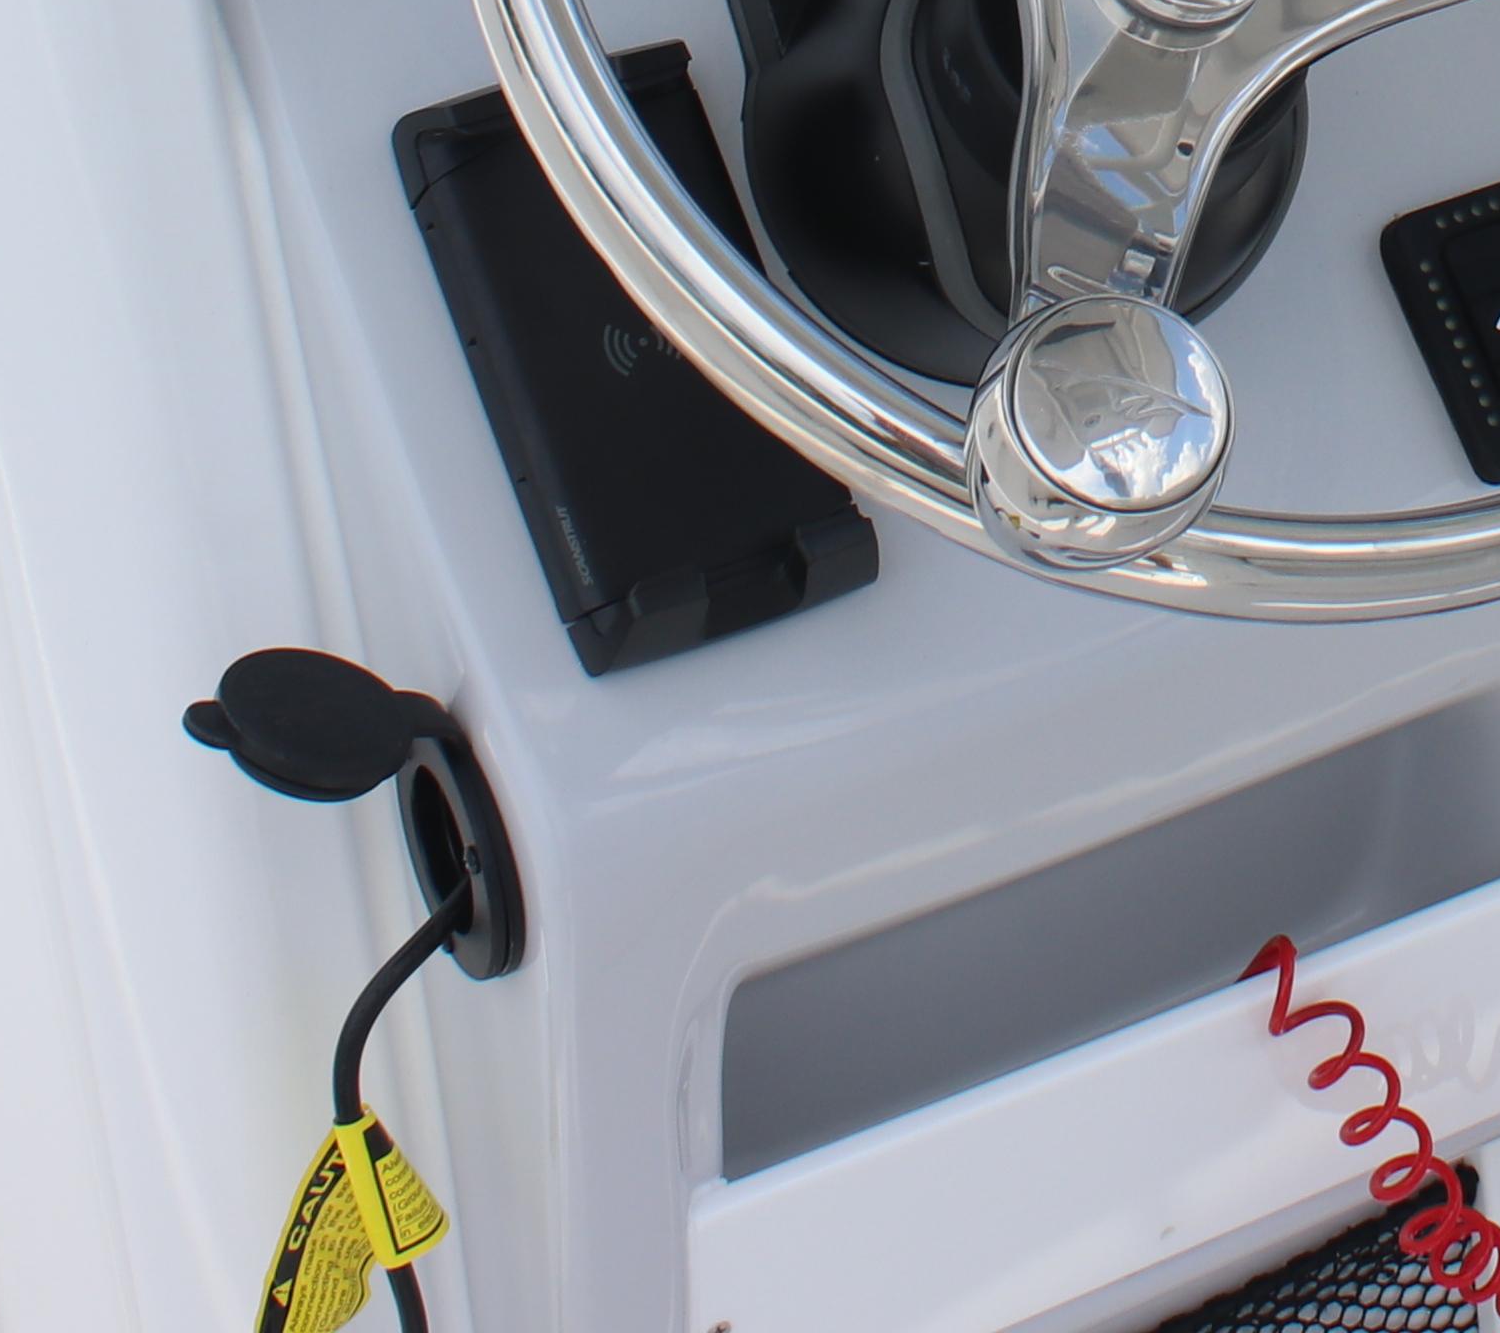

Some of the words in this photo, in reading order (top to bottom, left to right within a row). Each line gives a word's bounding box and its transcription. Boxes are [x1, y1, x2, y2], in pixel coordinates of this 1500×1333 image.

[554, 504, 595, 586] SCANSTRUT
[287, 1148, 347, 1252] CAUT
[303, 1238, 318, 1276] make
